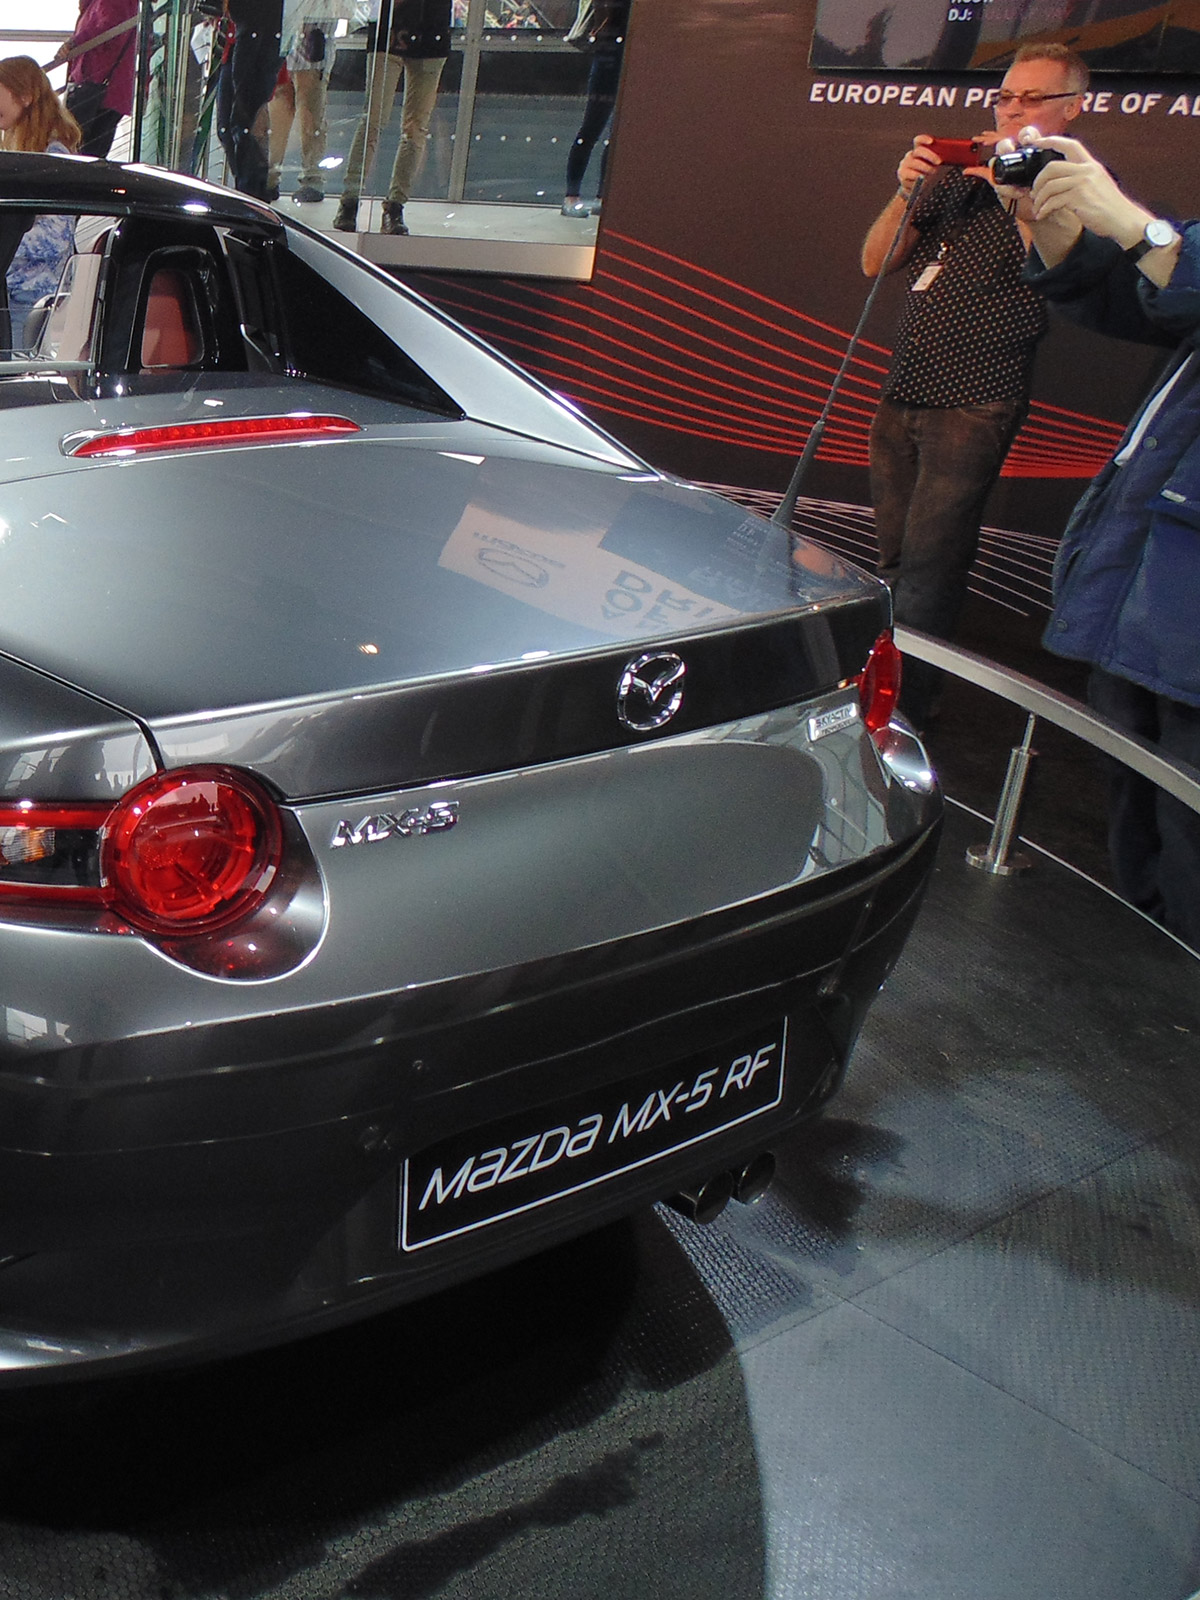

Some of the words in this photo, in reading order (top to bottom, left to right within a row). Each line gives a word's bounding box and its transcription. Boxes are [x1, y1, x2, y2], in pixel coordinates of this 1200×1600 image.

[948, 9, 972, 21] DJ:
[810, 83, 957, 106] EUROPEAN
[1121, 92, 1162, 114] OF
[330, 800, 460, 848] MX-5
[608, 1067, 719, 1143] MX-5
[720, 1042, 776, 1098] RF
